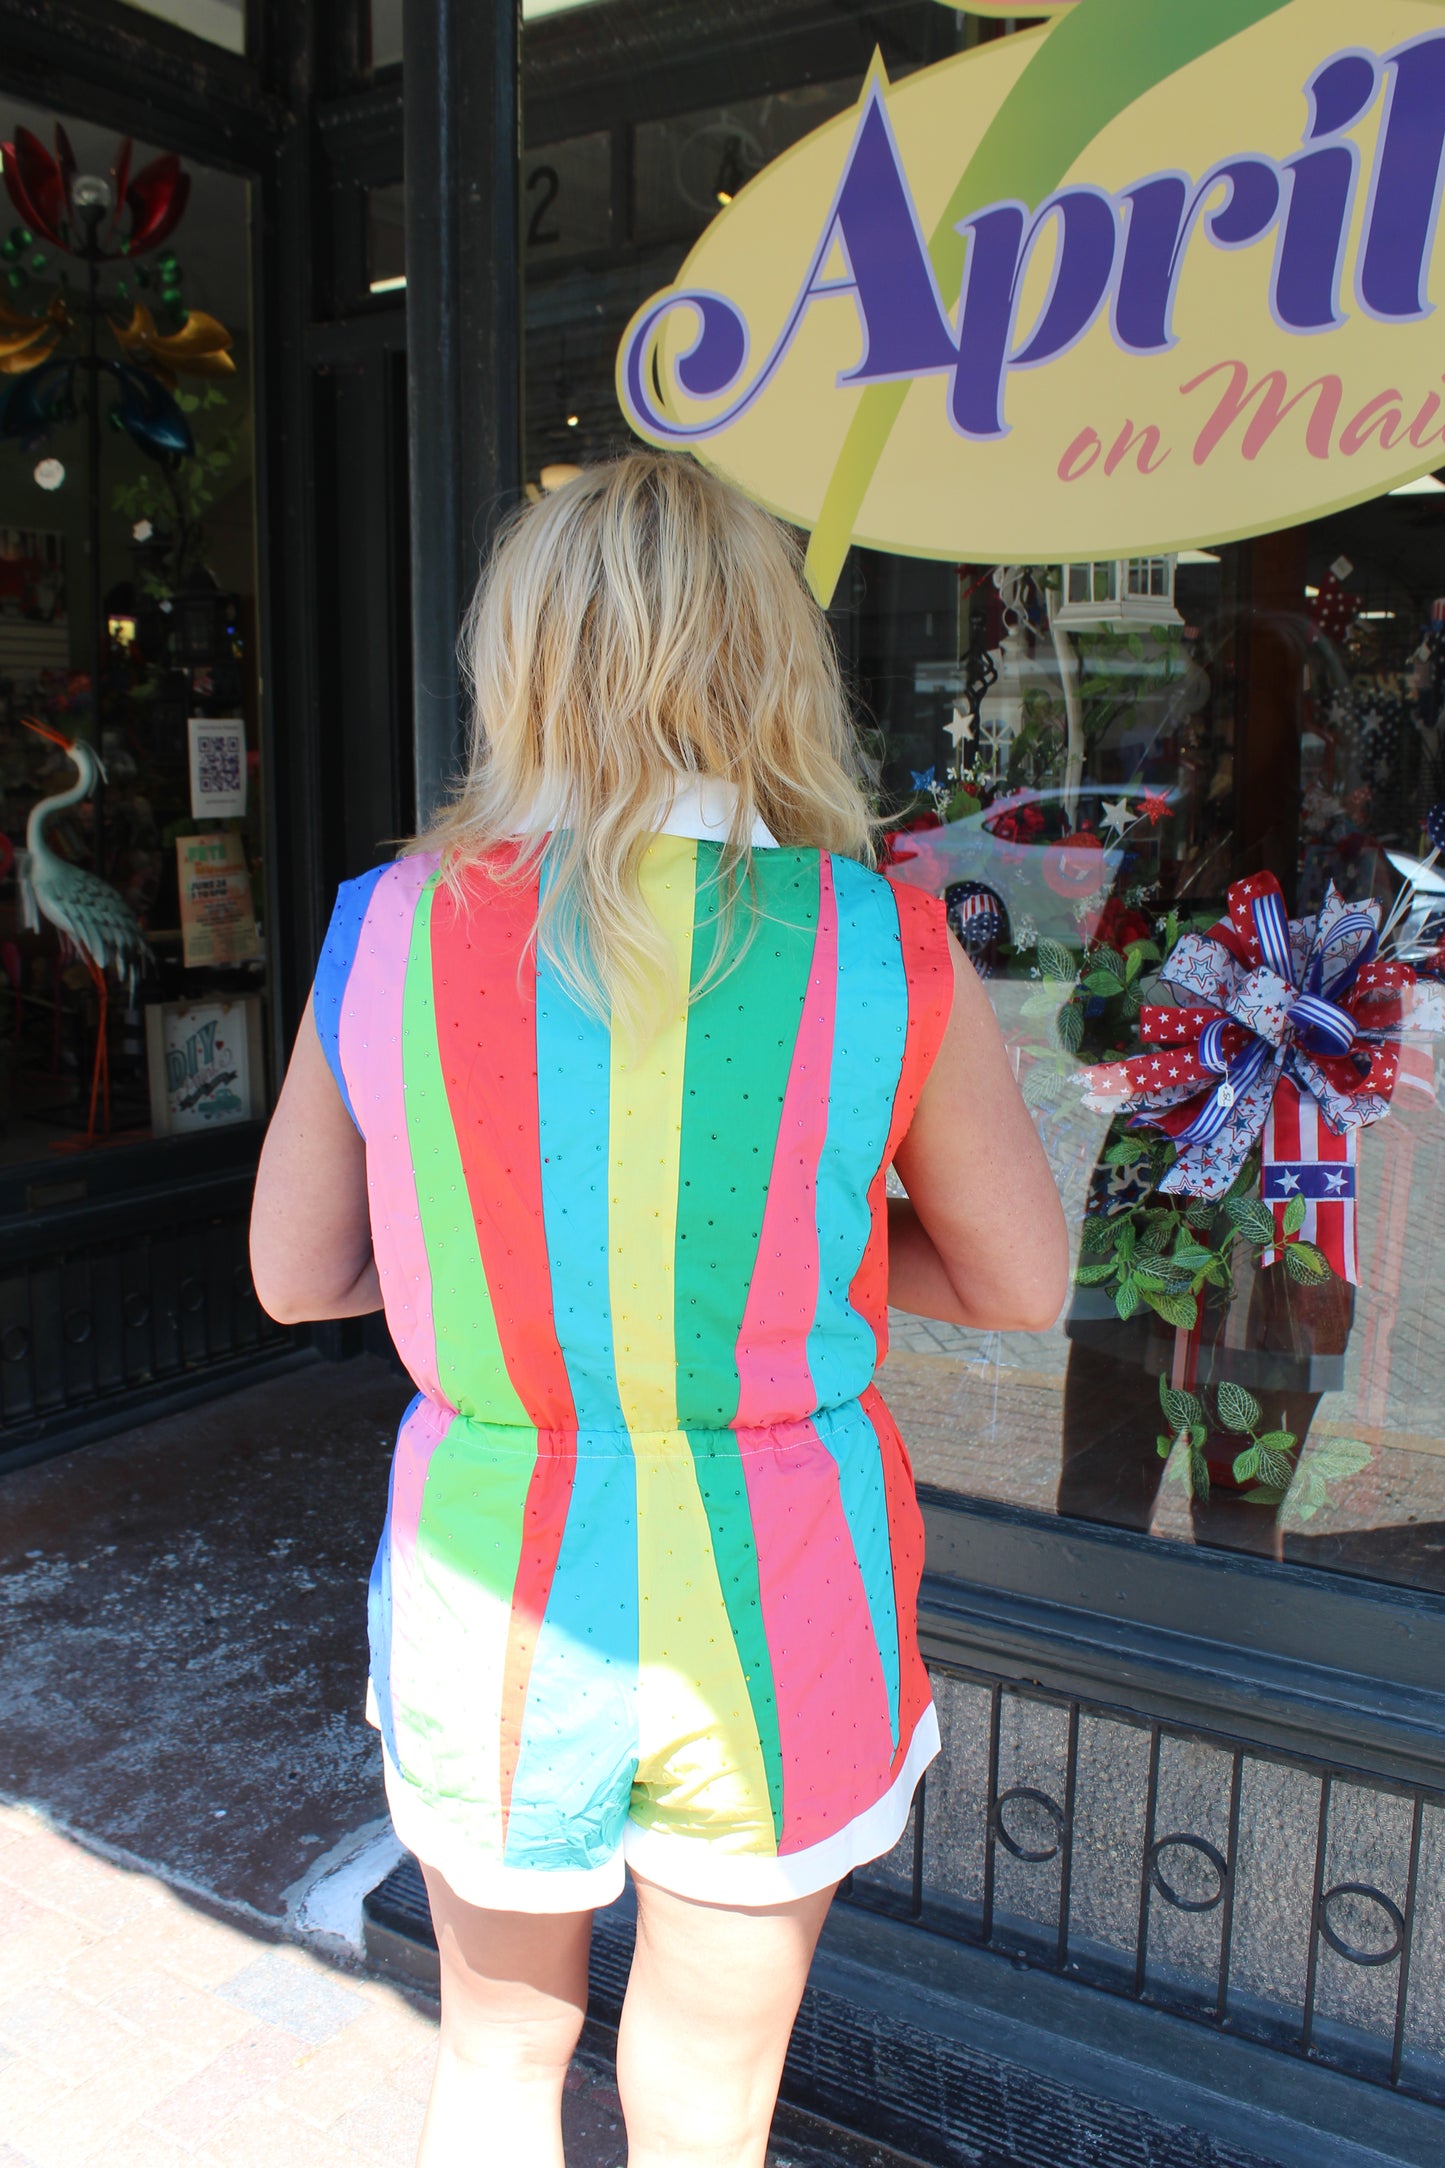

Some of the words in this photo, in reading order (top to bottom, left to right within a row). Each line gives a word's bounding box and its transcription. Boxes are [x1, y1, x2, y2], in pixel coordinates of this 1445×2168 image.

[527, 166, 559, 246] 2
[623, 28, 1445, 441] April
[1057, 419, 1172, 482] on
[1179, 360, 1445, 466] Mai
[165, 1019, 218, 1092] DIY
